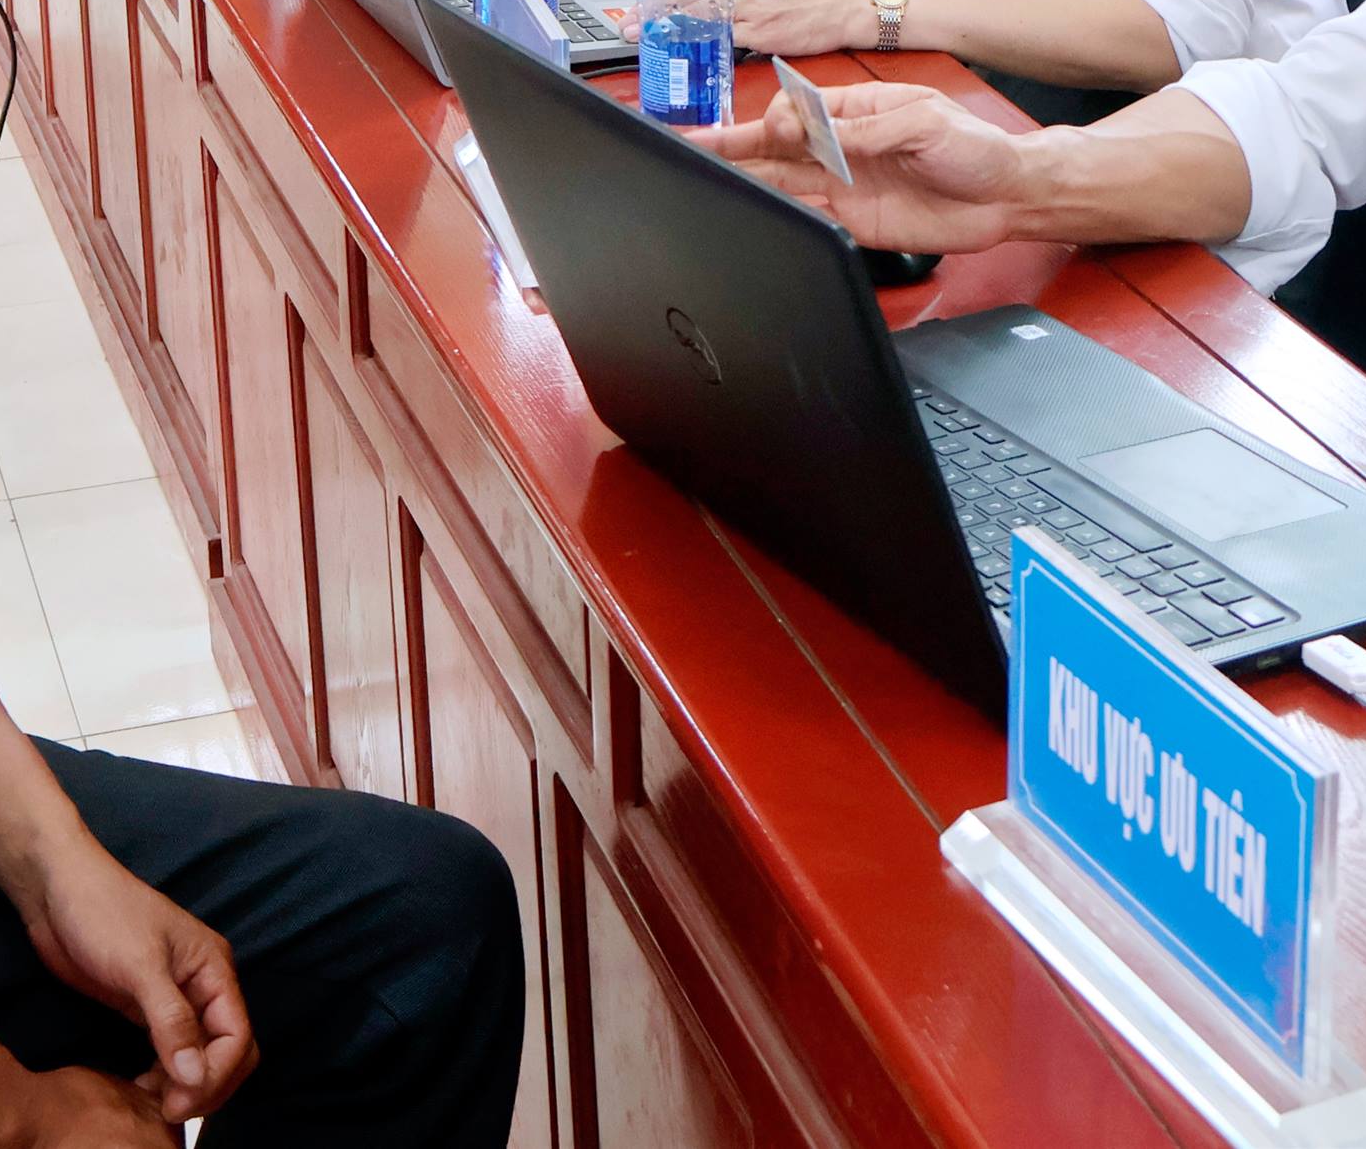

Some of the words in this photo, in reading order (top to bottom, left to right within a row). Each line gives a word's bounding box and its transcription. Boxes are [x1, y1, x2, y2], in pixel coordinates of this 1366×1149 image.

[1048, 655, 1099, 786] KHU
[1103, 701, 1155, 842] VỰC
[1159, 749, 1198, 873] ƯU
[1202, 786, 1267, 938] TIÊN
